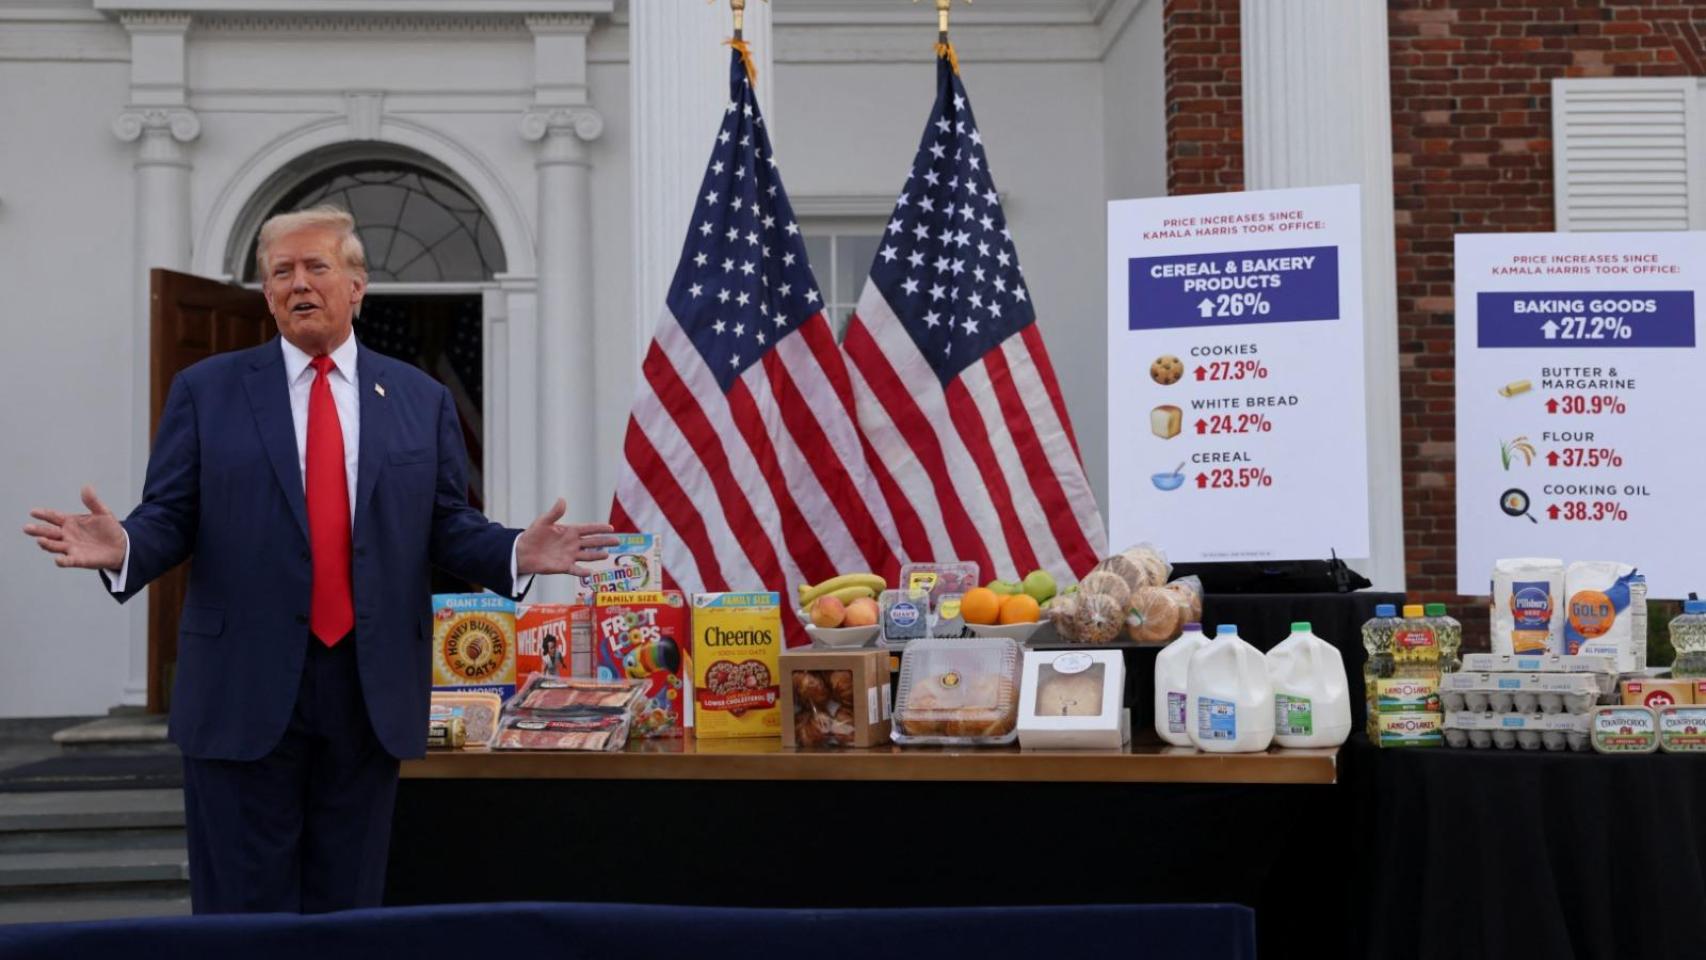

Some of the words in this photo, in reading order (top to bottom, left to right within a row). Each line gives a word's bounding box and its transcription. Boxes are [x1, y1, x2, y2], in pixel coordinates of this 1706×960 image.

[1163, 218, 1197, 228] PRICE
[1200, 213, 1265, 225] INCREASES
[1269, 210, 1304, 221] SINCE
[1143, 229, 1191, 240] KAMALA
[1196, 226, 1238, 236] HARRIS
[1243, 224, 1275, 234] TOOK
[1279, 221, 1326, 232] OFFICE:
[1150, 261, 1221, 278] CEREAL
[1225, 260, 1237, 273] &
[1242, 256, 1316, 273] BAKERY
[1513, 255, 1547, 264] PRICE
[1552, 254, 1619, 263] INCREASES
[1623, 254, 1658, 263] SINCE
[1492, 266, 1542, 275] KAMALA
[1547, 265, 1591, 275] HARRIS
[1596, 265, 1628, 274] TOOK
[1633, 265, 1681, 274] OFFICE:
[1184, 274, 1281, 293] PRODUCTS
[1216, 292, 1270, 317] 26%
[1513, 299, 1585, 314] BAKING
[1589, 299, 1657, 313] GOODS
[1560, 316, 1632, 339] 27.2%
[1190, 344, 1258, 357] COOKIES
[1209, 360, 1268, 381] 27.3%
[1542, 367, 1602, 378] BUTTER
[1608, 367, 1618, 378] &
[1542, 379, 1636, 390] MARGARINE
[1191, 397, 1240, 410] WHITE
[1246, 395, 1299, 408] BREAD
[1562, 395, 1626, 415] 30.9%
[1210, 413, 1272, 434] 24.2%
[1542, 431, 1595, 442] FLOUR
[1191, 451, 1251, 464] CEREAL
[1563, 448, 1623, 468] 37.5%
[1211, 467, 1273, 489] 23.5%
[1543, 484, 1618, 496] COOKING
[1624, 484, 1651, 497] OIL
[1563, 501, 1628, 521] 38.3%
[446, 598, 477, 609] GIANT
[481, 597, 504, 608] SIZE
[601, 595, 633, 603] FAMILY
[1572, 602, 1608, 617] GOLD
[601, 608, 657, 638] FROOT
[448, 623, 468, 656] HONEY
[469, 620, 502, 656] BUNCHES
[609, 626, 661, 652] LOOPS
[704, 626, 772, 647] Cheerios
[465, 660, 497, 677] OATS
